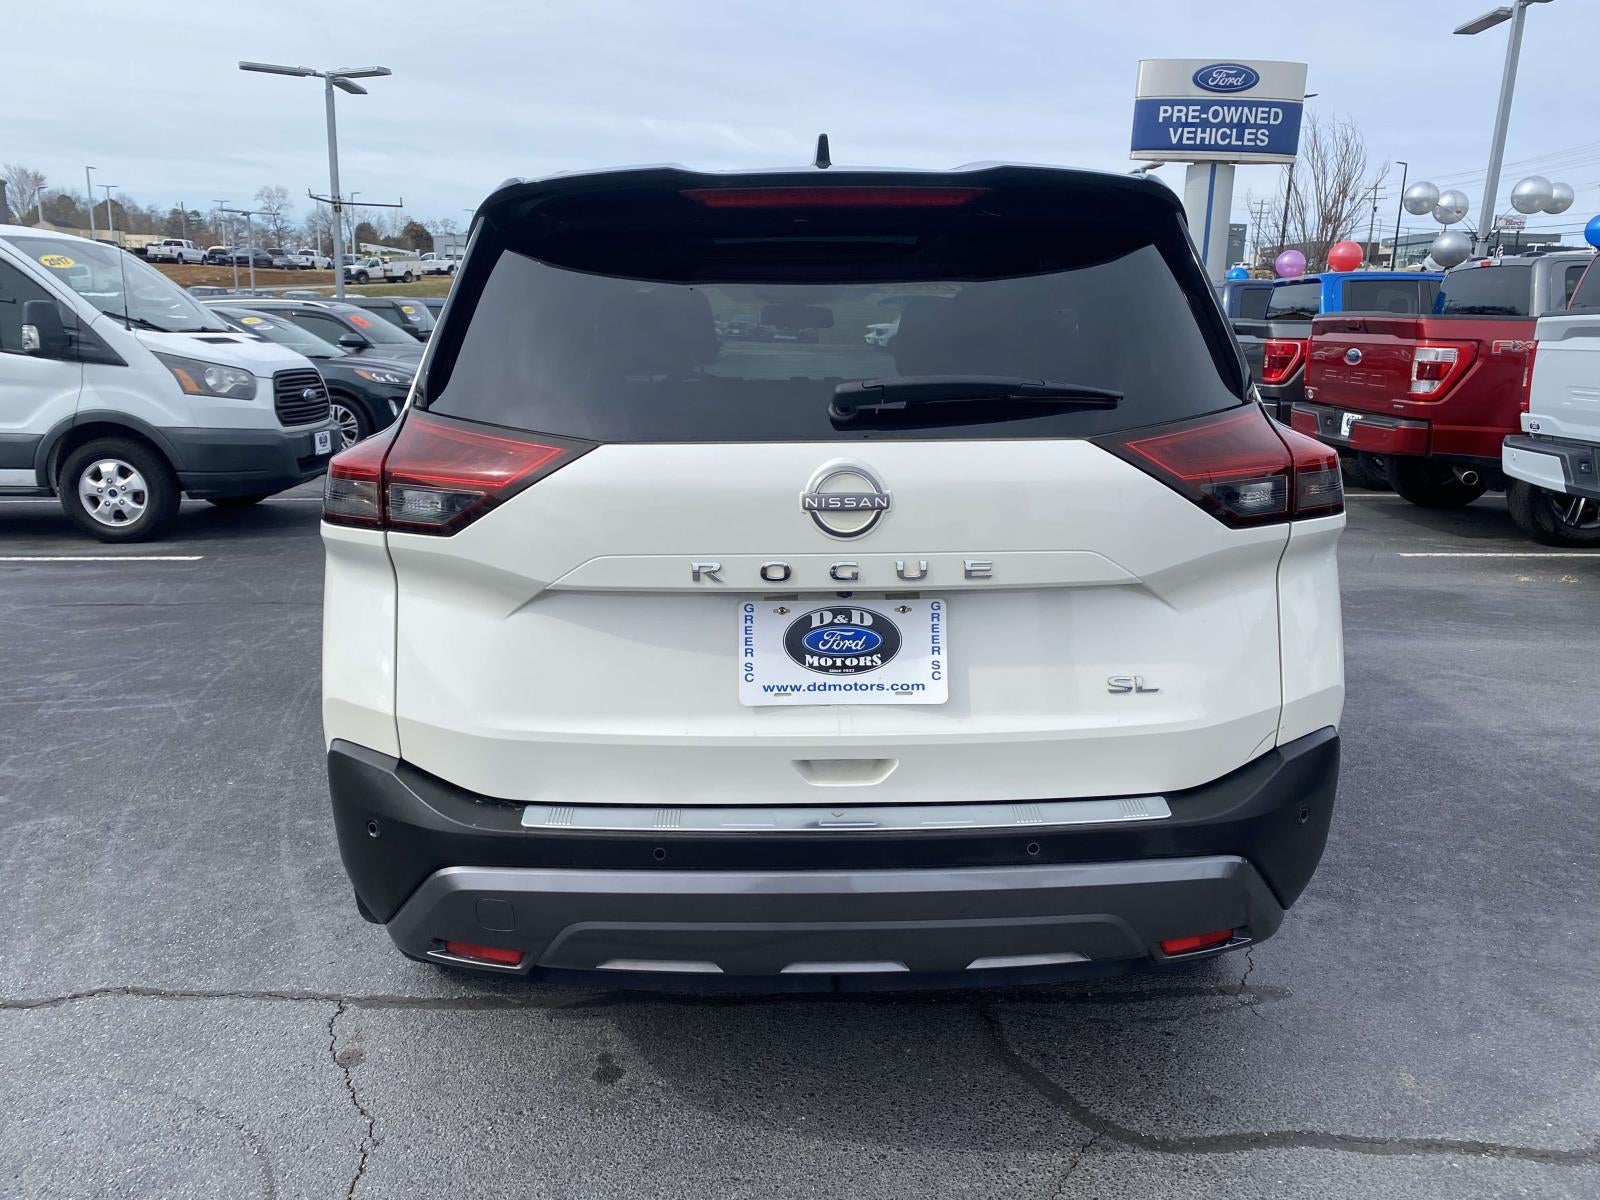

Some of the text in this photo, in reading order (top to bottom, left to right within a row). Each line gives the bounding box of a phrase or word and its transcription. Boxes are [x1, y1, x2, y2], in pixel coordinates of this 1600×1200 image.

[1208, 69, 1246, 86] Ford
[1158, 105, 1283, 125] PRE-OWNED
[1169, 128, 1269, 146] VEHICLES
[805, 496, 888, 508] NISSAN
[691, 559, 994, 583] ROGUE
[810, 610, 873, 628] D&D
[744, 603, 755, 683] GREER SC
[819, 630, 865, 650] Ford
[930, 601, 942, 681] GREER SC
[805, 654, 882, 667] MOTORS
[762, 681, 926, 693] www.ddmotors.com
[1107, 676, 1160, 694] SL
